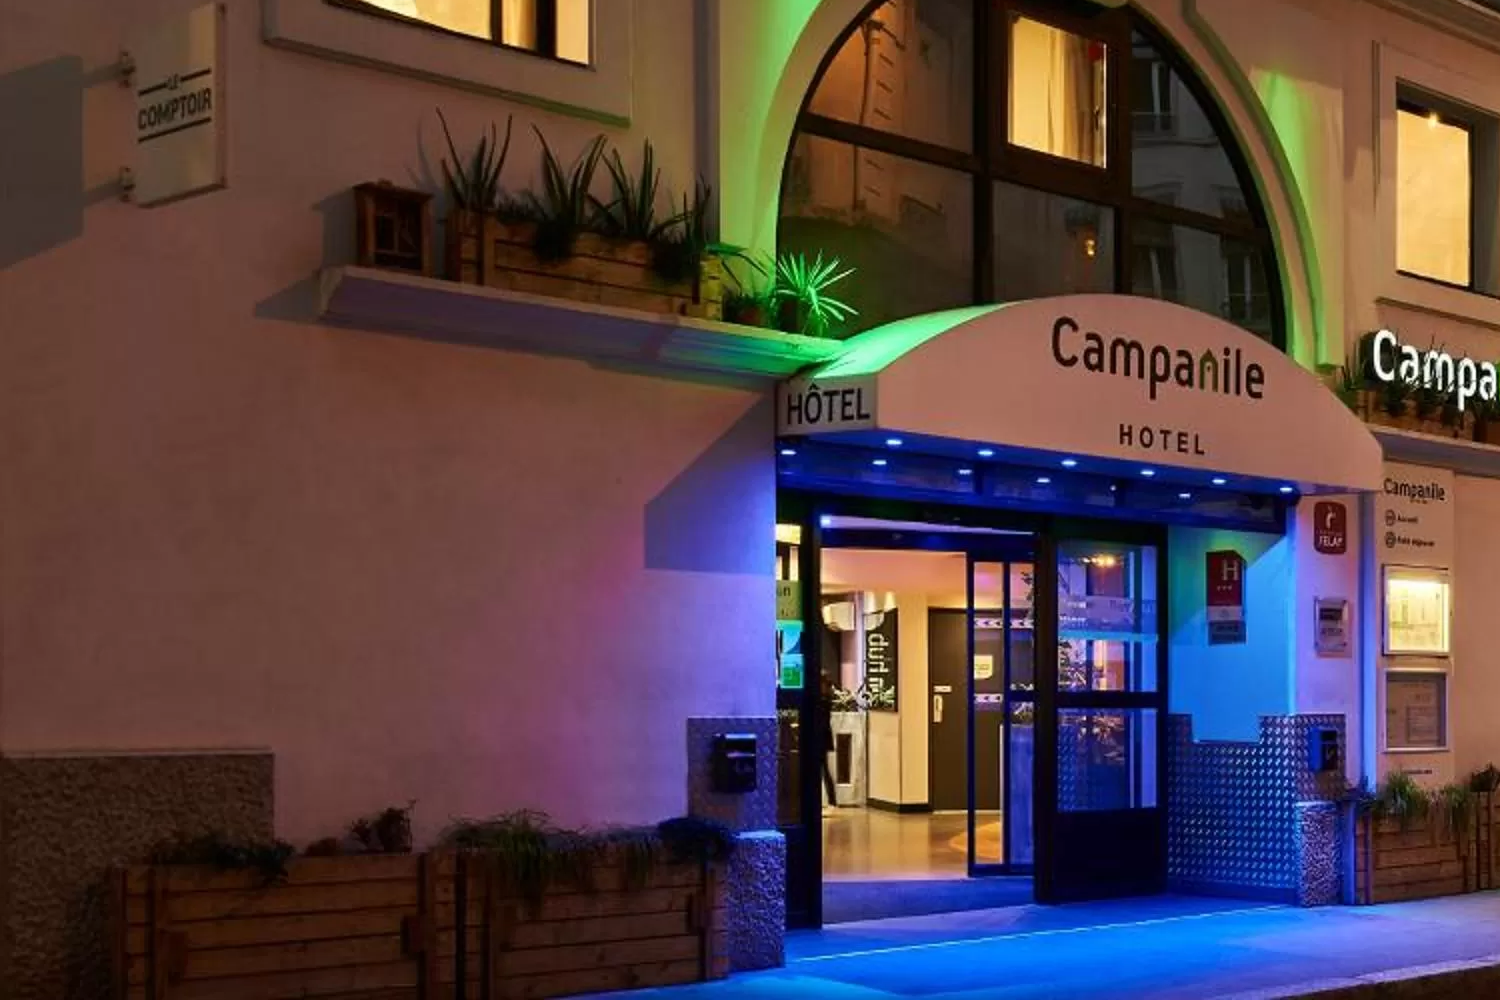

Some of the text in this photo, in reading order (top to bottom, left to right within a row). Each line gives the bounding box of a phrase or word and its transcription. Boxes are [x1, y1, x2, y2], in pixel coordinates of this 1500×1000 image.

[138, 87, 212, 131] COMPTOIR
[1052, 316, 1265, 401] Campanile
[787, 382, 871, 425] HÔTEL
[1119, 423, 1205, 455] HOTEL
[1223, 559, 1239, 581] H
